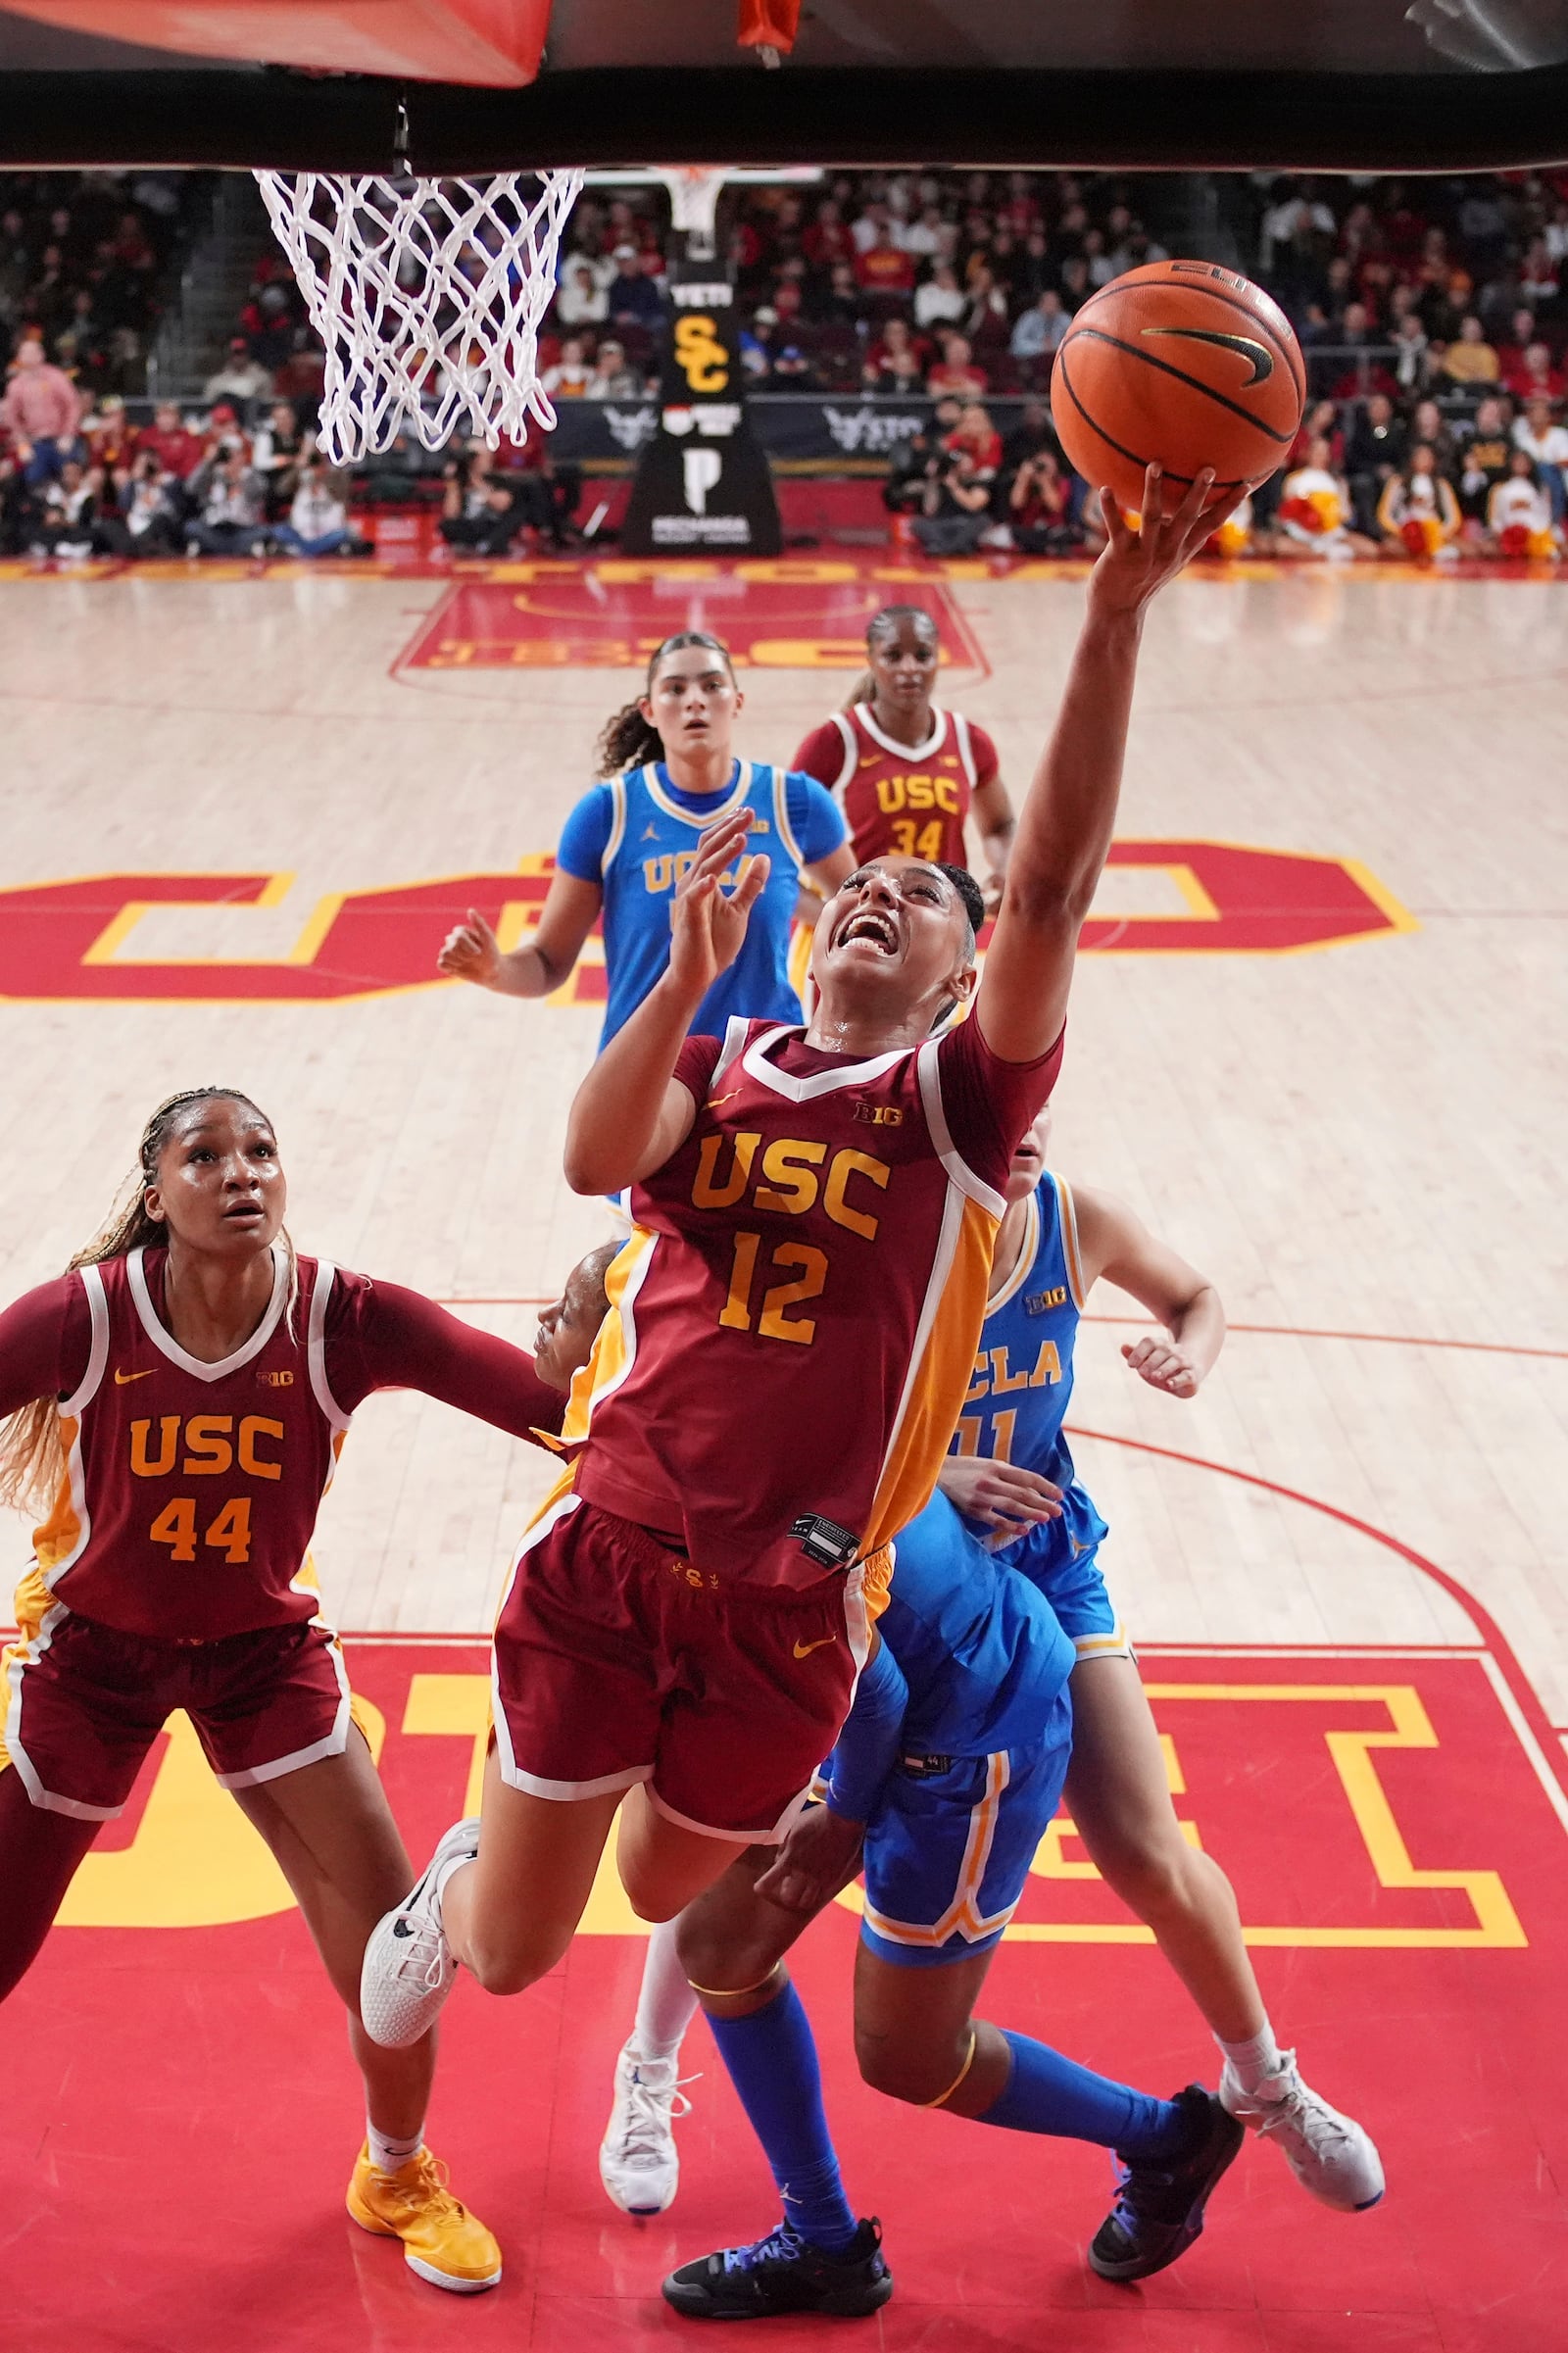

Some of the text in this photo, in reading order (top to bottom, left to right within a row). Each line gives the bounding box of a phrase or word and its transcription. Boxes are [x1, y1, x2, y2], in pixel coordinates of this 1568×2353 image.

[875, 775, 960, 815] USC
[888, 818, 943, 862] 34
[691, 1132, 892, 1242] USC
[718, 1231, 829, 1346] 12
[963, 1339, 1063, 1395] CLA
[130, 1414, 284, 1481] USC
[149, 1497, 252, 1563] 44
